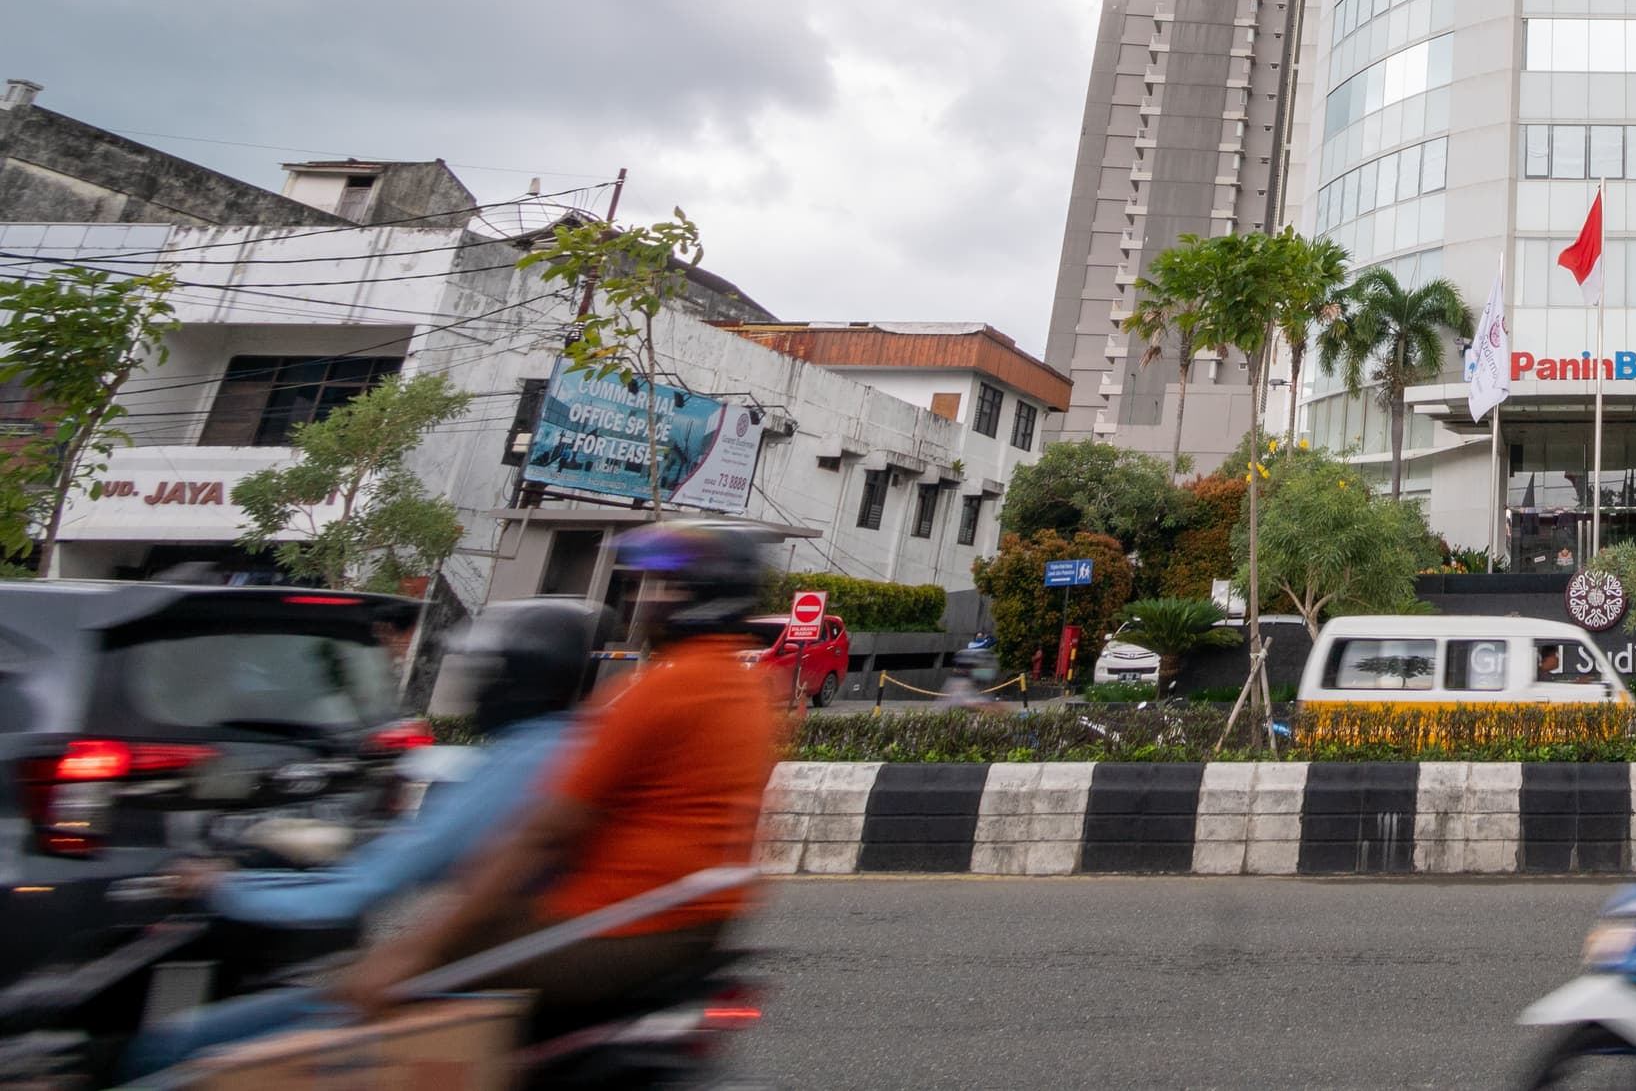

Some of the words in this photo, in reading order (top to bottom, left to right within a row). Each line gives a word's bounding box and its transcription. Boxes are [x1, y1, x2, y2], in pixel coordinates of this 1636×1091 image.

[577, 379, 677, 418] COMMERIAL
[568, 402, 625, 433] OFFICE
[573, 432, 606, 457] FOR
[608, 440, 656, 465] LEASE
[144, 481, 224, 506] JAYA
[719, 472, 729, 487] 73
[1470, 643, 1564, 674] Grd
